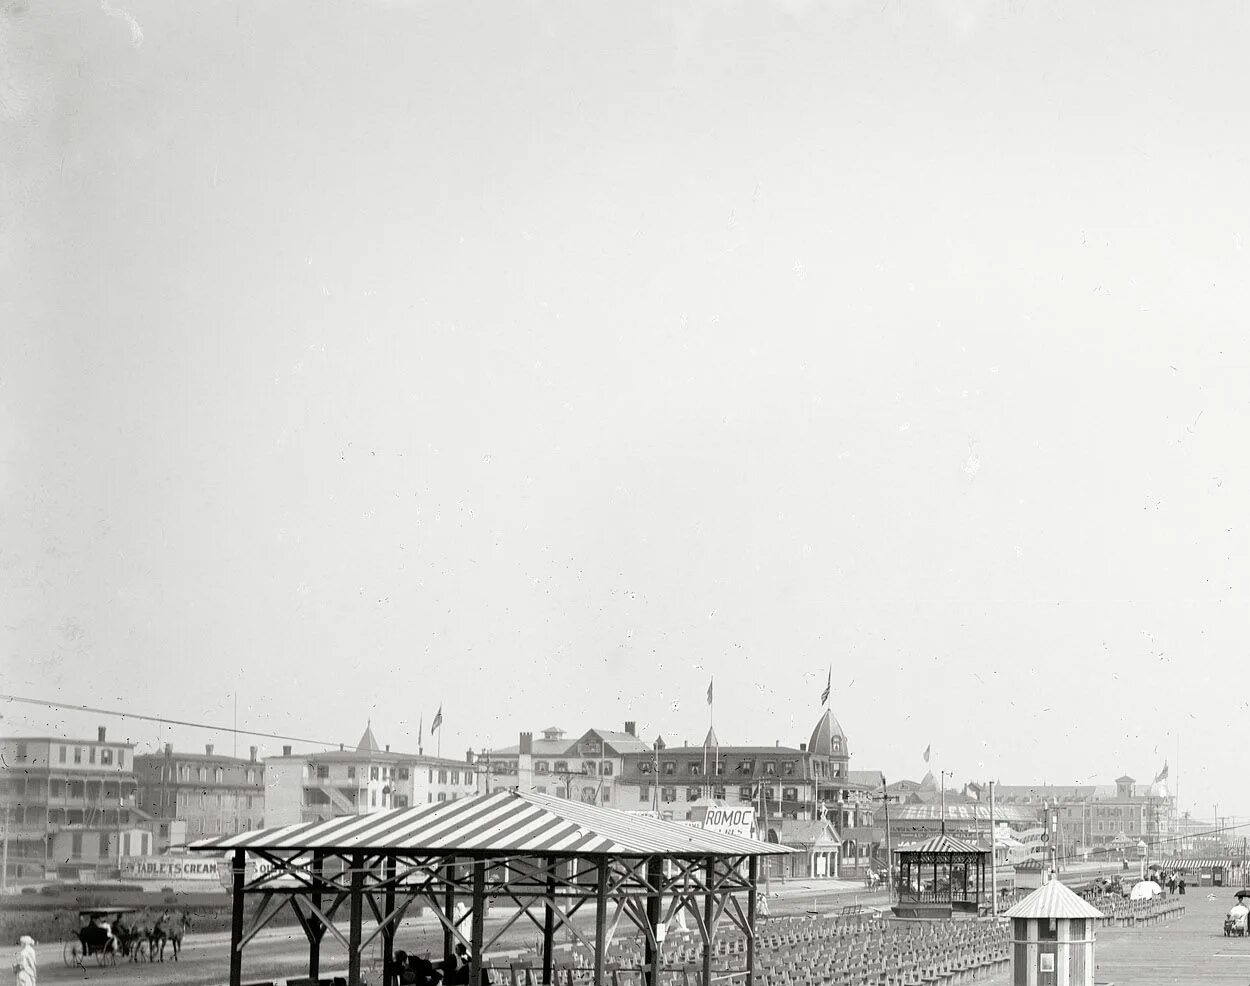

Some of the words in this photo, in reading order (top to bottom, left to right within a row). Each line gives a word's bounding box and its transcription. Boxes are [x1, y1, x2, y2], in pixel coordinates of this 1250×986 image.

[705, 810, 752, 826] ROMOC
[137, 863, 182, 874] TABLETS
[183, 863, 217, 873] CREAM
